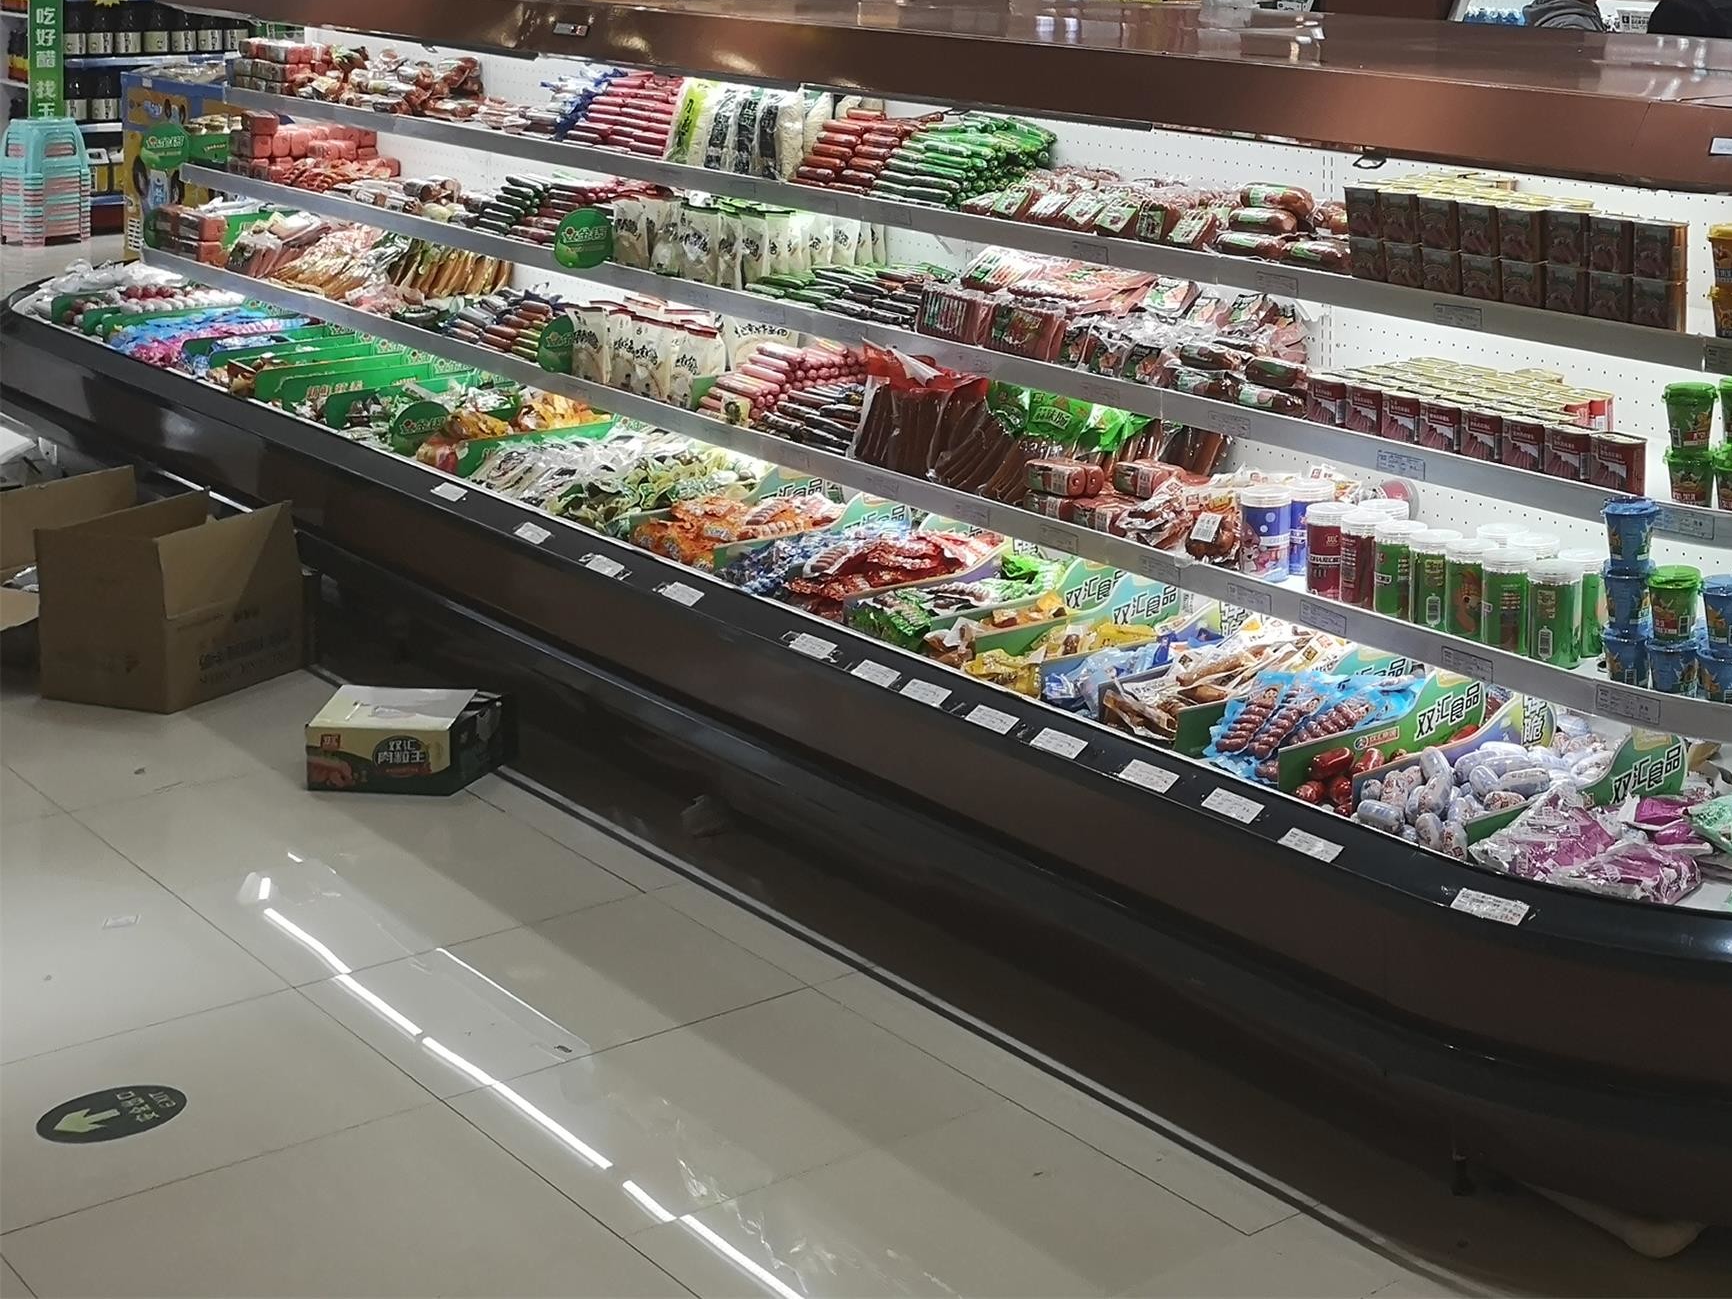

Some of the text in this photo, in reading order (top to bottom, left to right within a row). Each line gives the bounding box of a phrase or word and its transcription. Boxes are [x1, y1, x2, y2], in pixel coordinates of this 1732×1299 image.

[35, 7, 56, 68] 吃好醋
[1113, 585, 1177, 625] 双汇食品
[1416, 683, 1480, 739] 双汇食品
[389, 739, 416, 751] 双汇
[1613, 744, 1682, 805] 双汇食品
